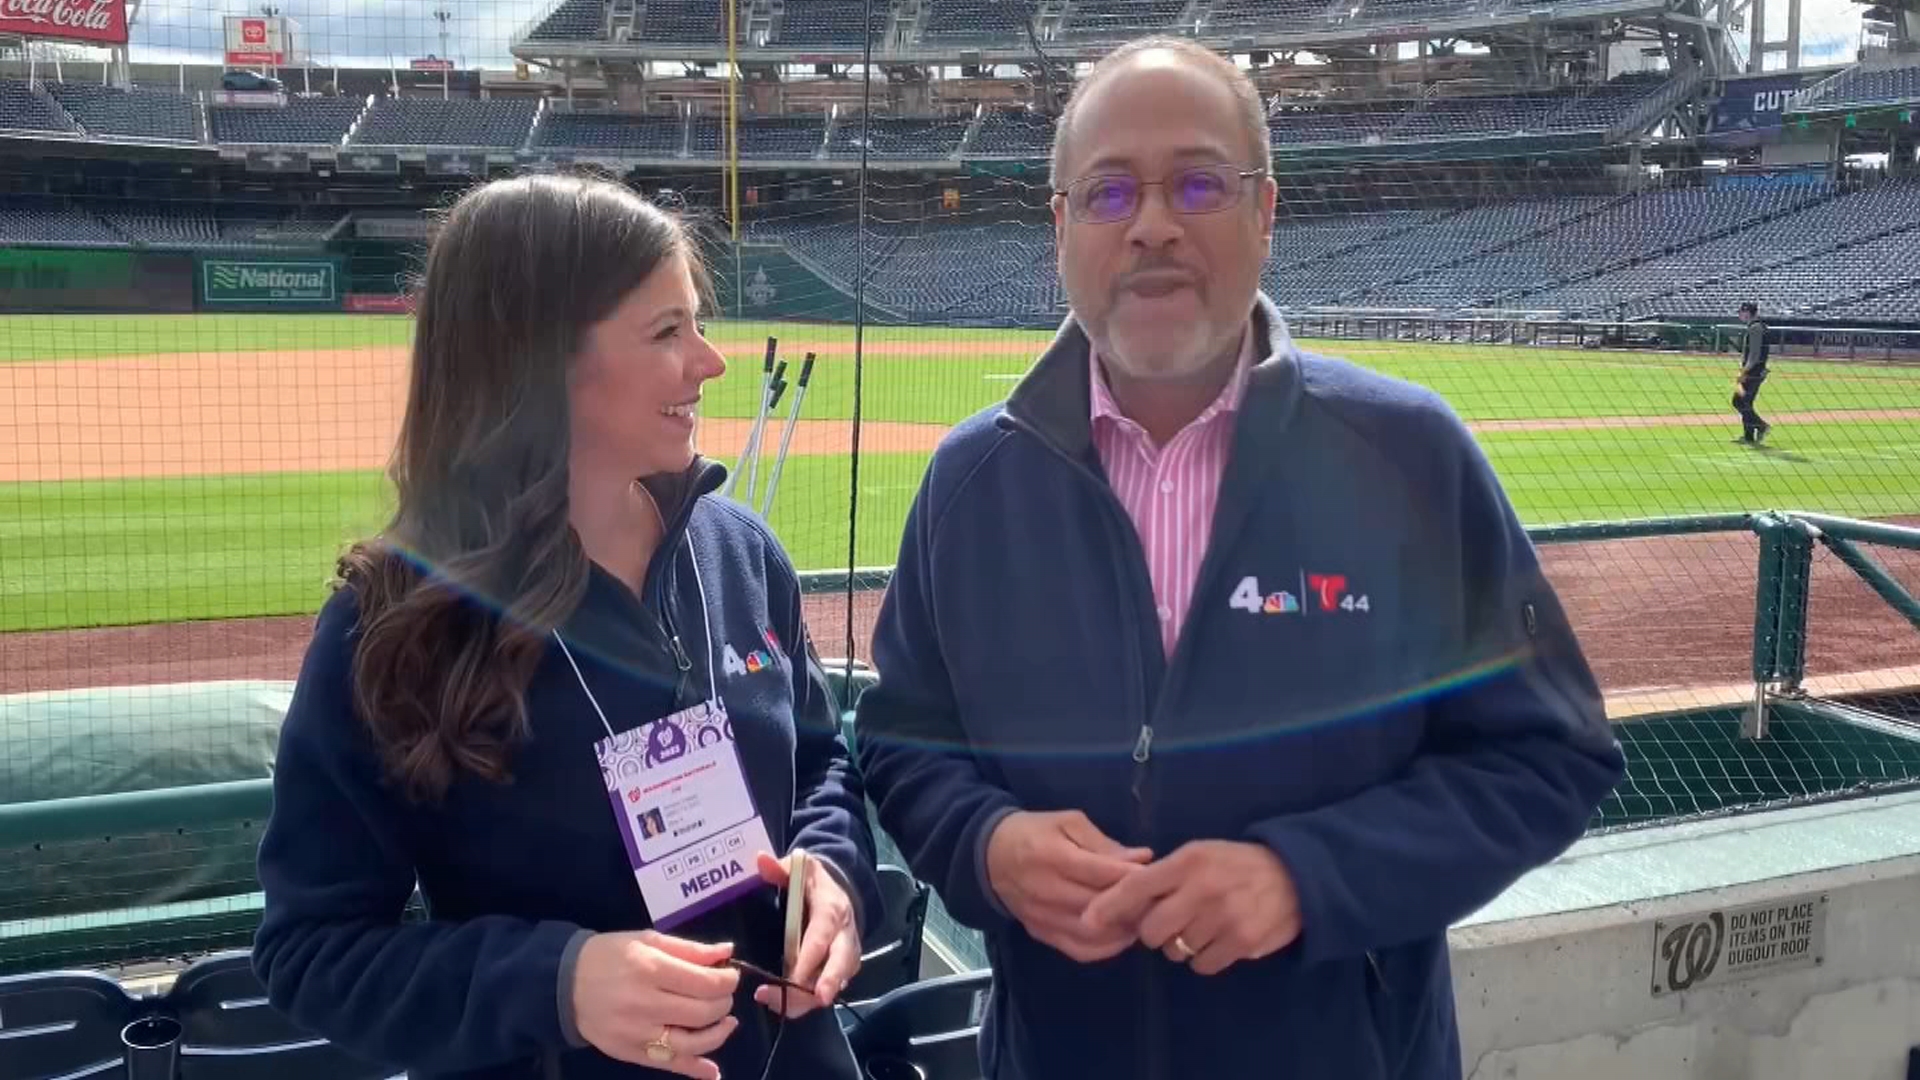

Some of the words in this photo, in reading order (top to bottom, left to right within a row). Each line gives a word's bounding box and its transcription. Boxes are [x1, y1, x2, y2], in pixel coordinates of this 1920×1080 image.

[239, 267, 327, 289] National
[1229, 576, 1263, 613] 4
[1340, 594, 1370, 612] 44
[680, 859, 744, 898] MEDIA
[1730, 915, 1747, 931] DO
[1750, 909, 1774, 928] NOT
[1777, 902, 1814, 921] PLACE
[1729, 929, 1767, 949] ITEMS
[1769, 924, 1786, 940] ON
[1790, 920, 1813, 936] THE
[1728, 944, 1777, 965] DUGOUT
[1780, 937, 1811, 955] ROOF
